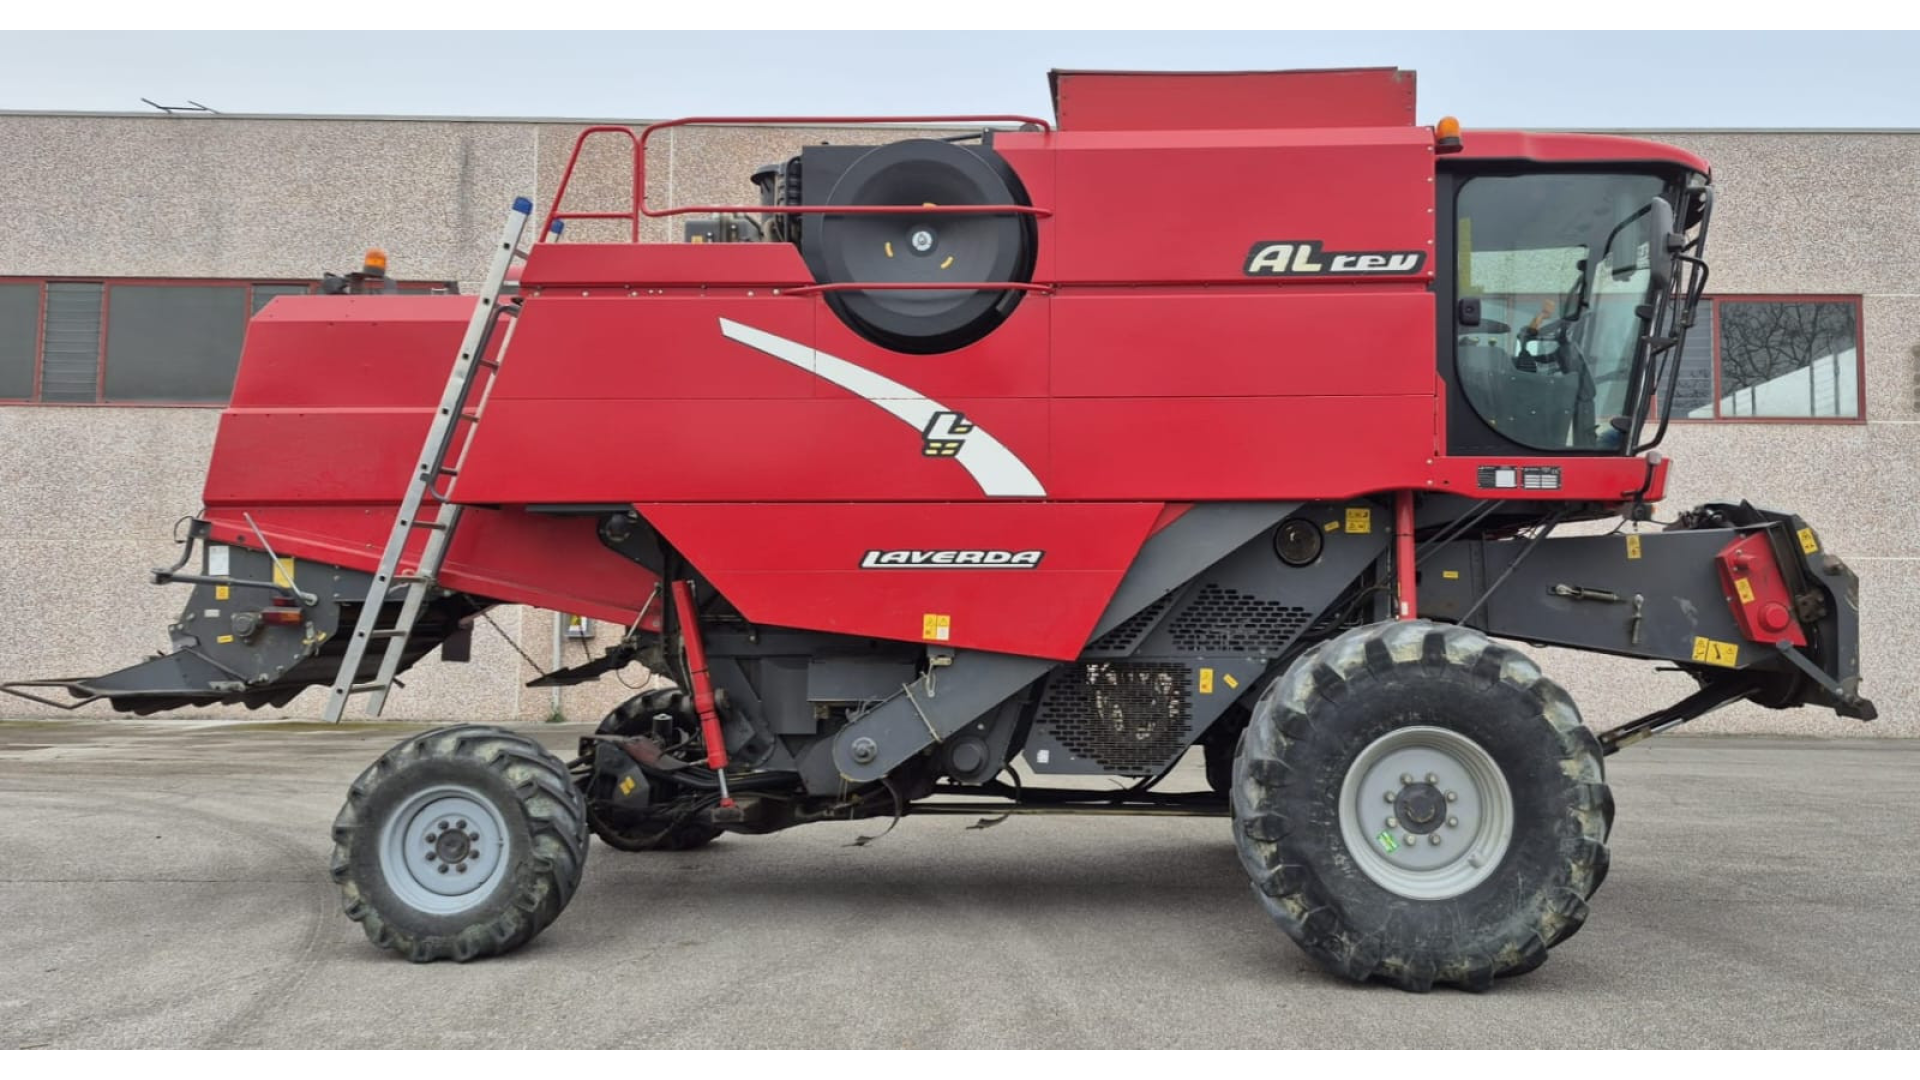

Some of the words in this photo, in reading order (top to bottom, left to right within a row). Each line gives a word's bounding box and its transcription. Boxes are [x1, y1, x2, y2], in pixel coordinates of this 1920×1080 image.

[1248, 243, 1323, 272] AL
[1330, 253, 1419, 271] rev
[861, 550, 1043, 568] LAVERDA
